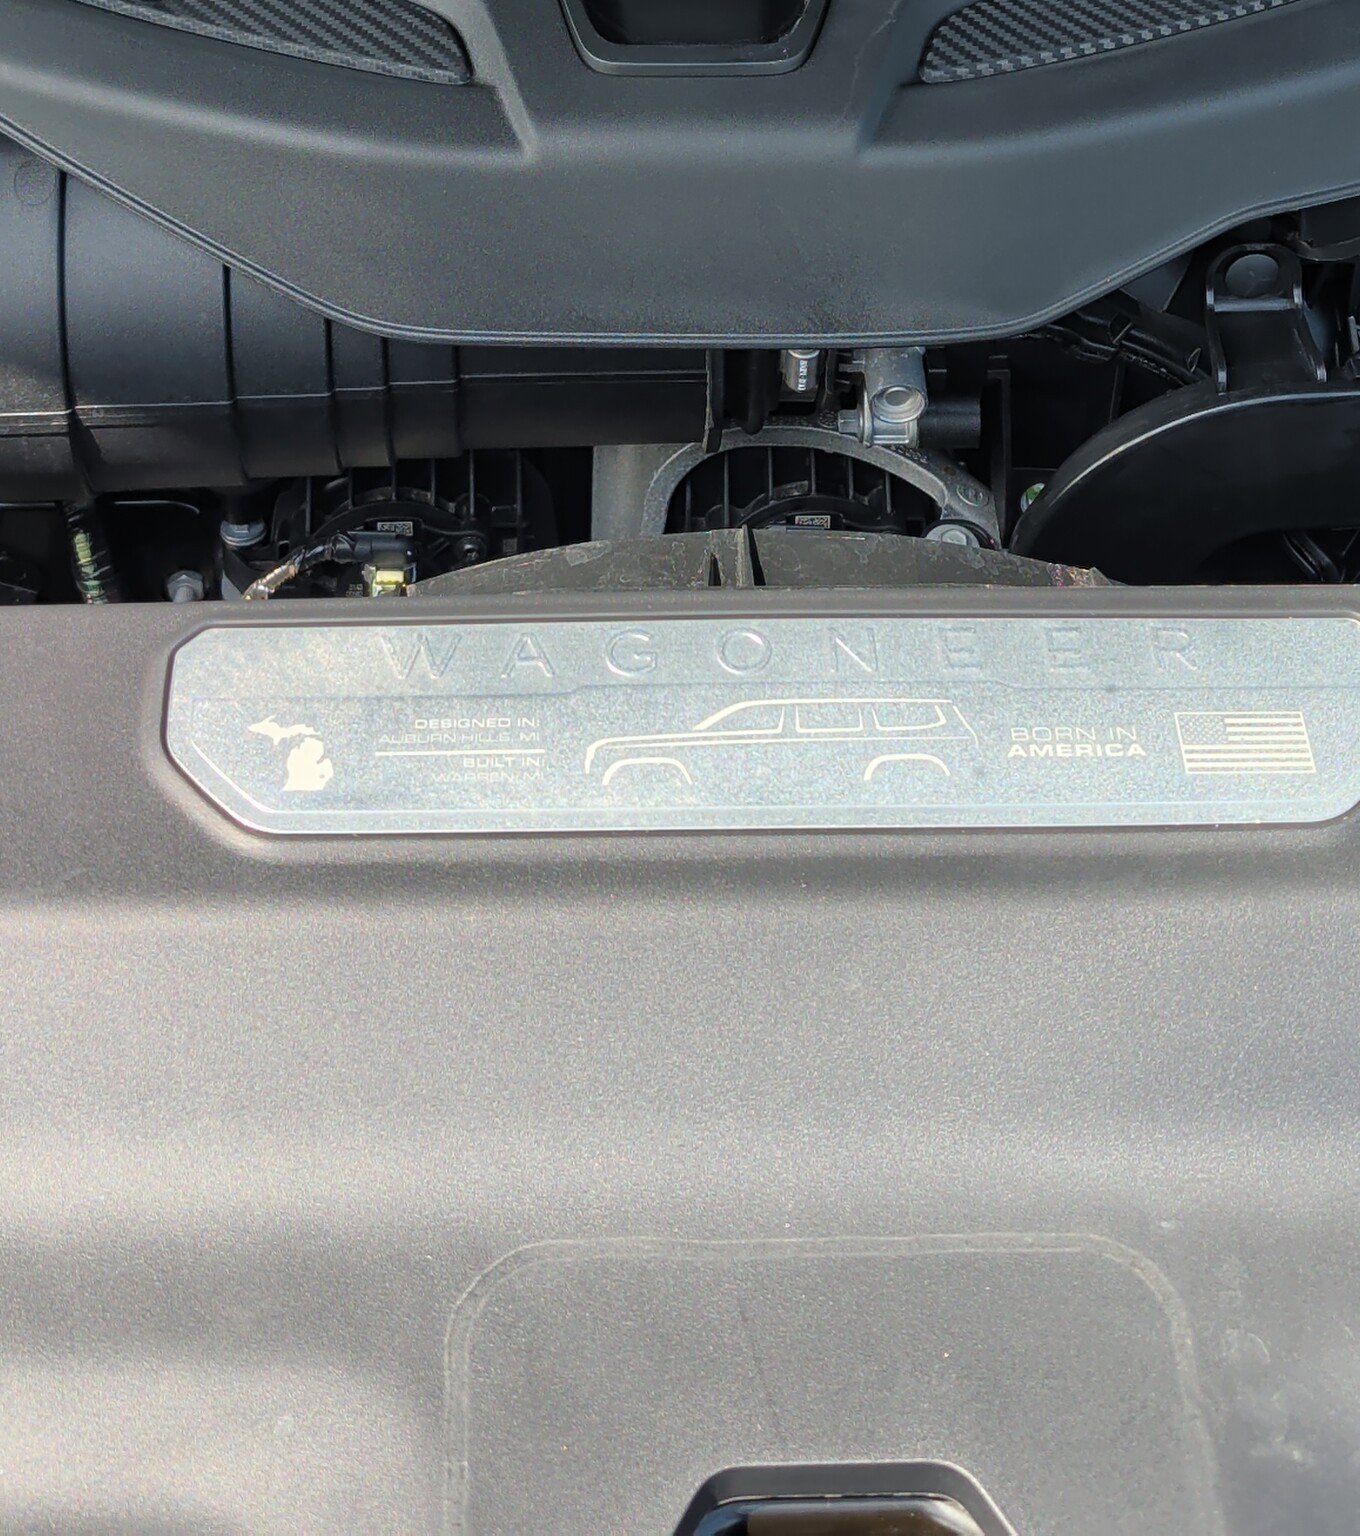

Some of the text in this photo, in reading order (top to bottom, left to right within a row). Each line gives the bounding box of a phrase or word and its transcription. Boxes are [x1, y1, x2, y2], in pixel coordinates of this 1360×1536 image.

[383, 626, 1200, 679] WAGONEER
[414, 717, 512, 730] DESIGNED
[378, 733, 457, 745] AUBURN
[519, 731, 540, 742] MI
[1010, 726, 1137, 742] BORN IN
[1007, 742, 1148, 758] AMERICA
[462, 757, 516, 768] BUILT
[522, 770, 544, 782] MI
